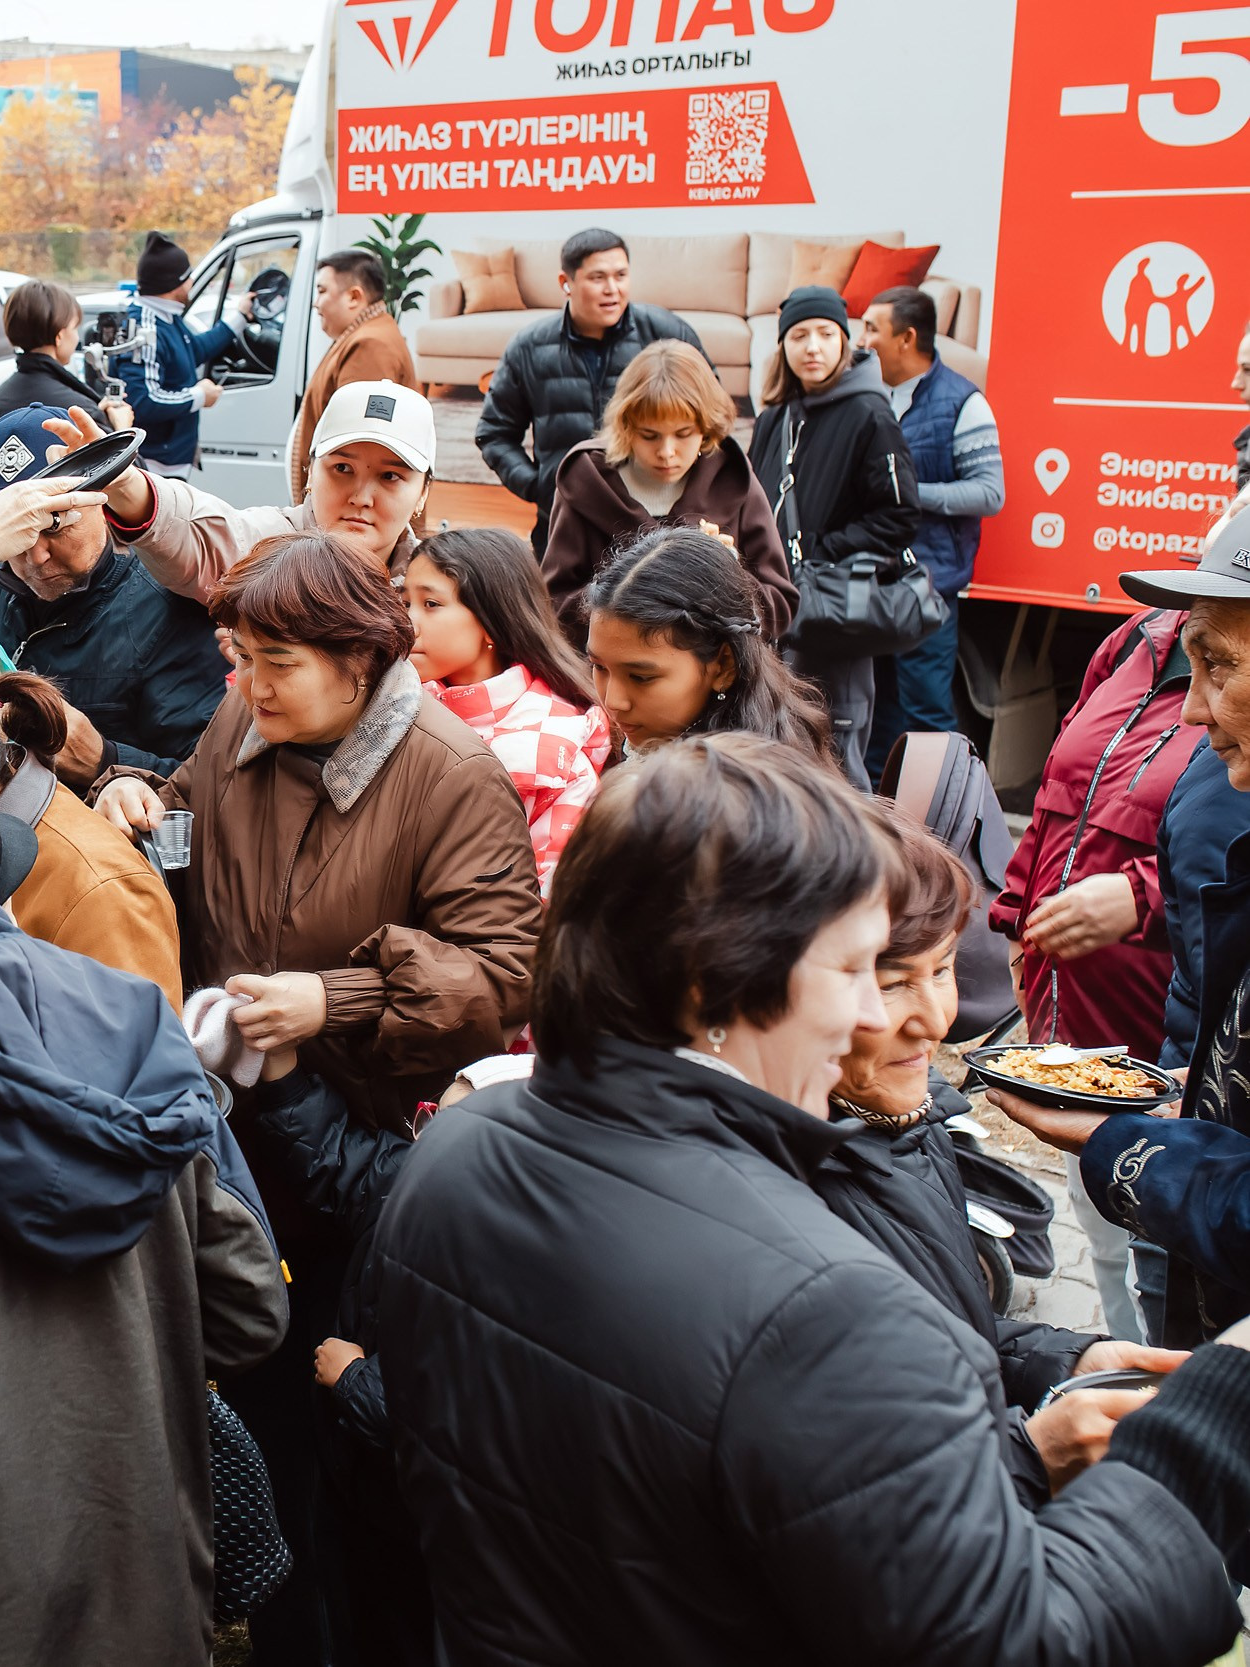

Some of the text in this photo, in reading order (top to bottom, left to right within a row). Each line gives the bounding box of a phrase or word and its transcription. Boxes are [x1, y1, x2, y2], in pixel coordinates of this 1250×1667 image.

[631, 48, 751, 75] ОРТАЛЫҒЫ
[455, 110, 648, 149] ТҮРЛЕРІНІҢ
[348, 153, 656, 197] ЕҢ ҮЛКЕН ТАҢДАУЫ
[1100, 451, 1238, 484] Энергети
